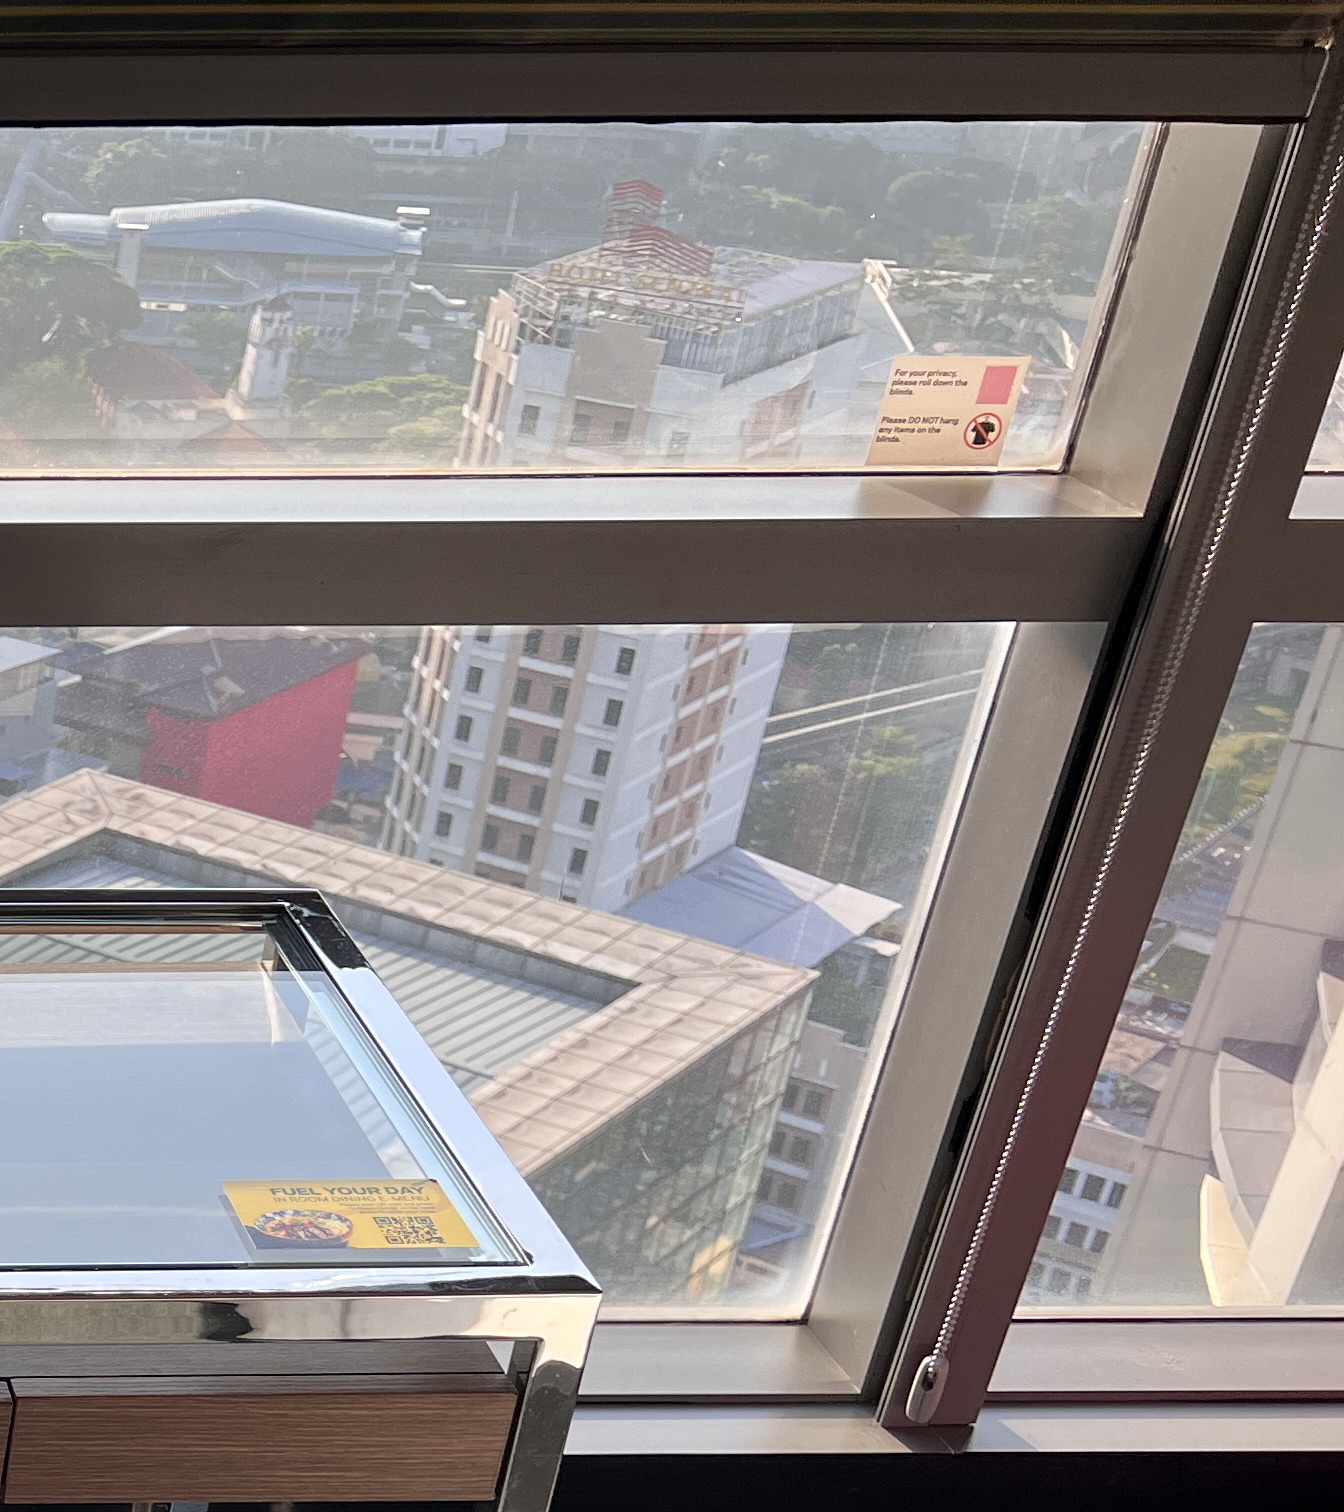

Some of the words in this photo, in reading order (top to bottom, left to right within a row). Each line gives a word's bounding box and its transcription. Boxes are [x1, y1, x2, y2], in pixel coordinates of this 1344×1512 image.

[549, 262, 625, 285] HOTEL
[894, 368, 908, 377] For
[927, 369, 957, 378] privacy,
[891, 378, 917, 386] please
[881, 416, 907, 424] Please
[908, 416, 921, 424] DO
[922, 416, 940, 424] NOT
[940, 417, 959, 425] hang
[270, 1187, 322, 1196] FUEL
[322, 1186, 382, 1195] YOUR
[384, 1186, 425, 1195] DAY
